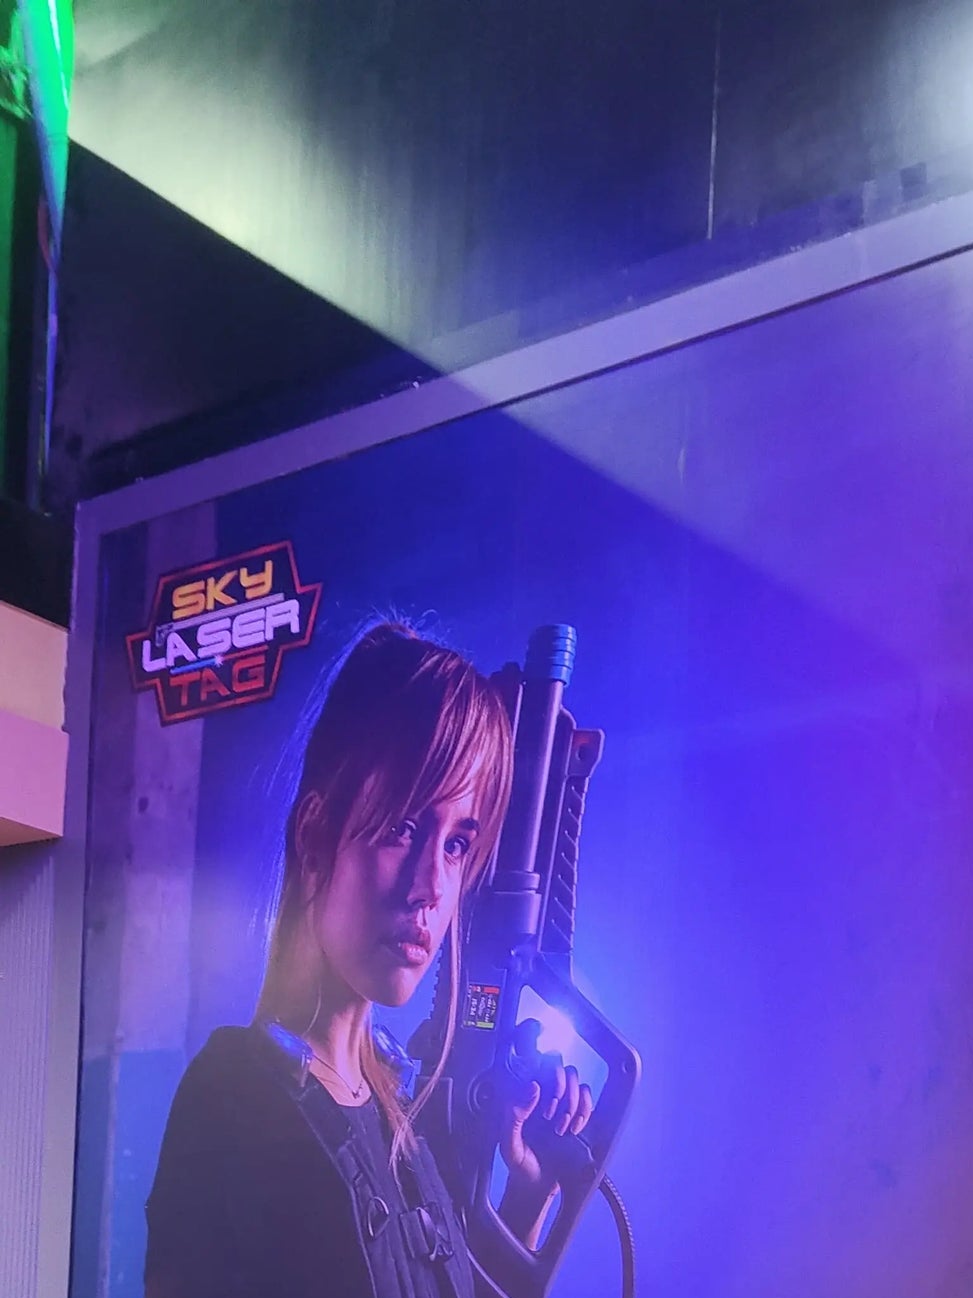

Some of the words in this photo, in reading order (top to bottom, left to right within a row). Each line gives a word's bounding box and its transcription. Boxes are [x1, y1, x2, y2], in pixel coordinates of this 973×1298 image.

[172, 560, 273, 620] SKY
[142, 599, 300, 672] LASER
[169, 654, 266, 706] TAG
